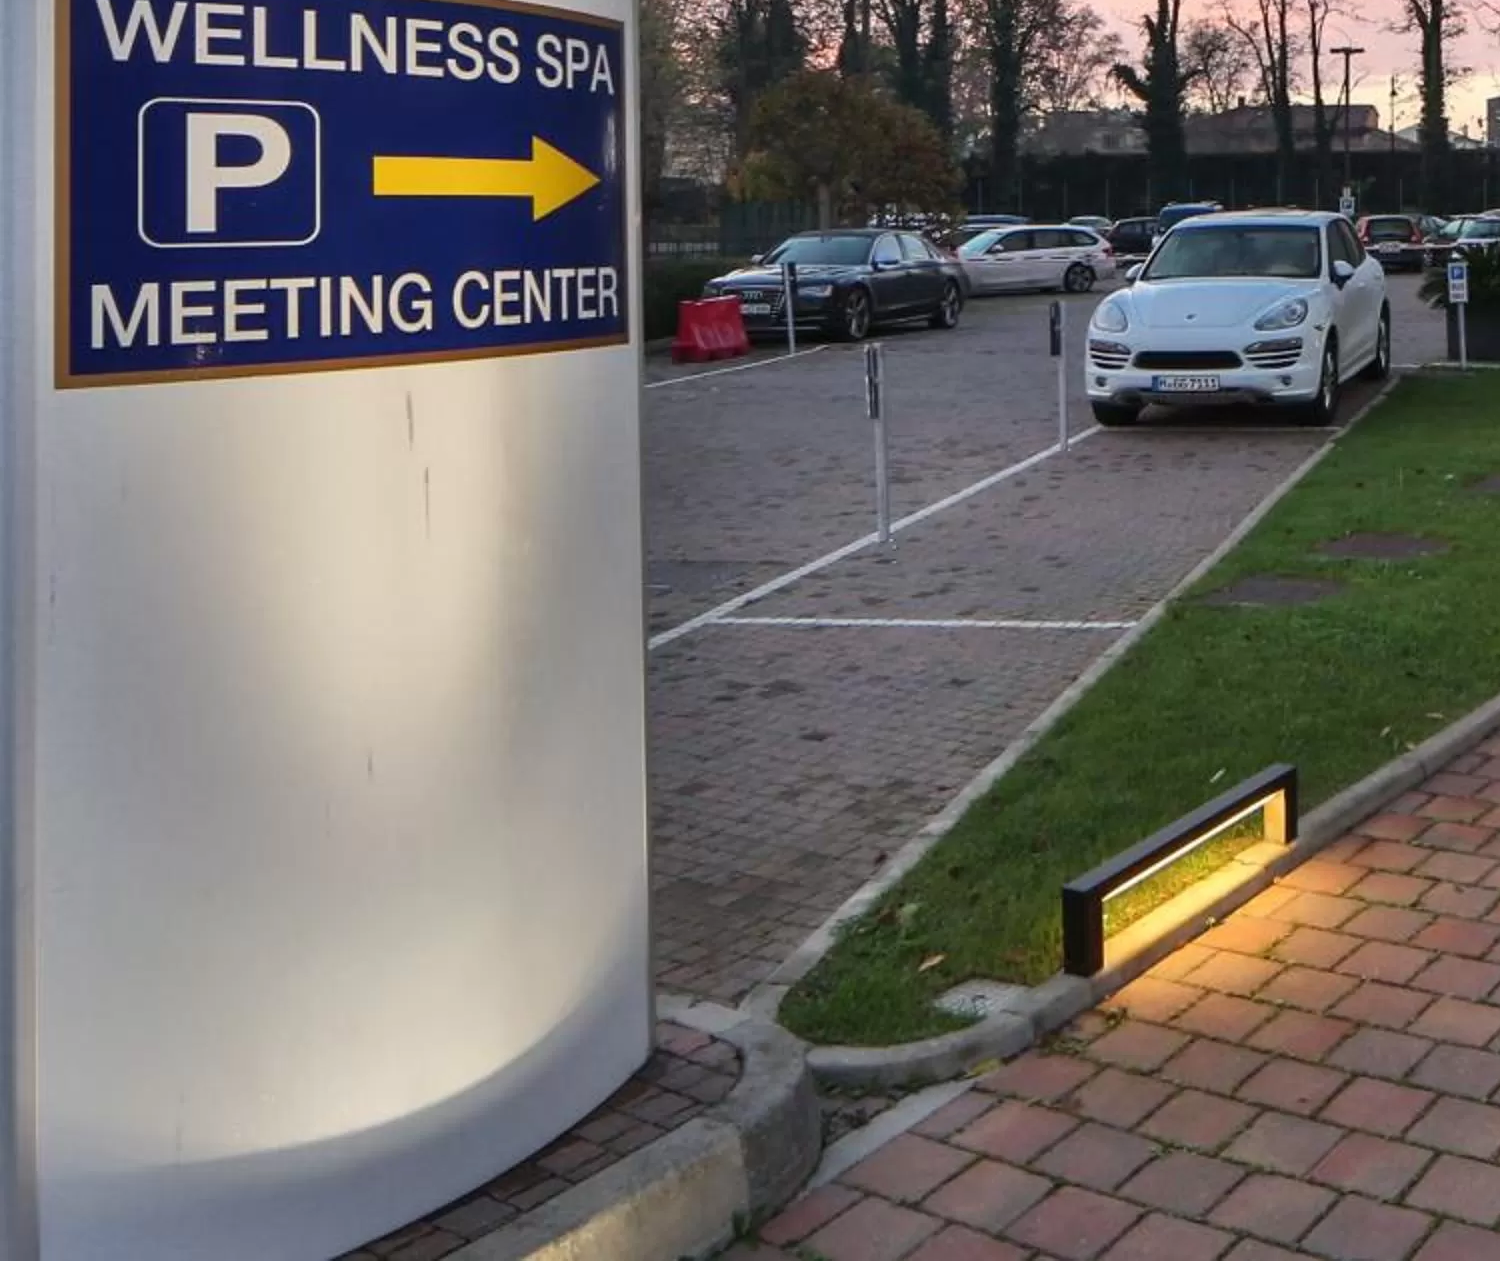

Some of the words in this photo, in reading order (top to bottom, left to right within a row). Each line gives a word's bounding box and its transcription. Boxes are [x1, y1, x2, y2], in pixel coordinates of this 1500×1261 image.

[535, 33, 615, 95] SPA
[185, 112, 292, 234] P
[90, 272, 432, 349] MEETING
[452, 266, 618, 329] CENTER
